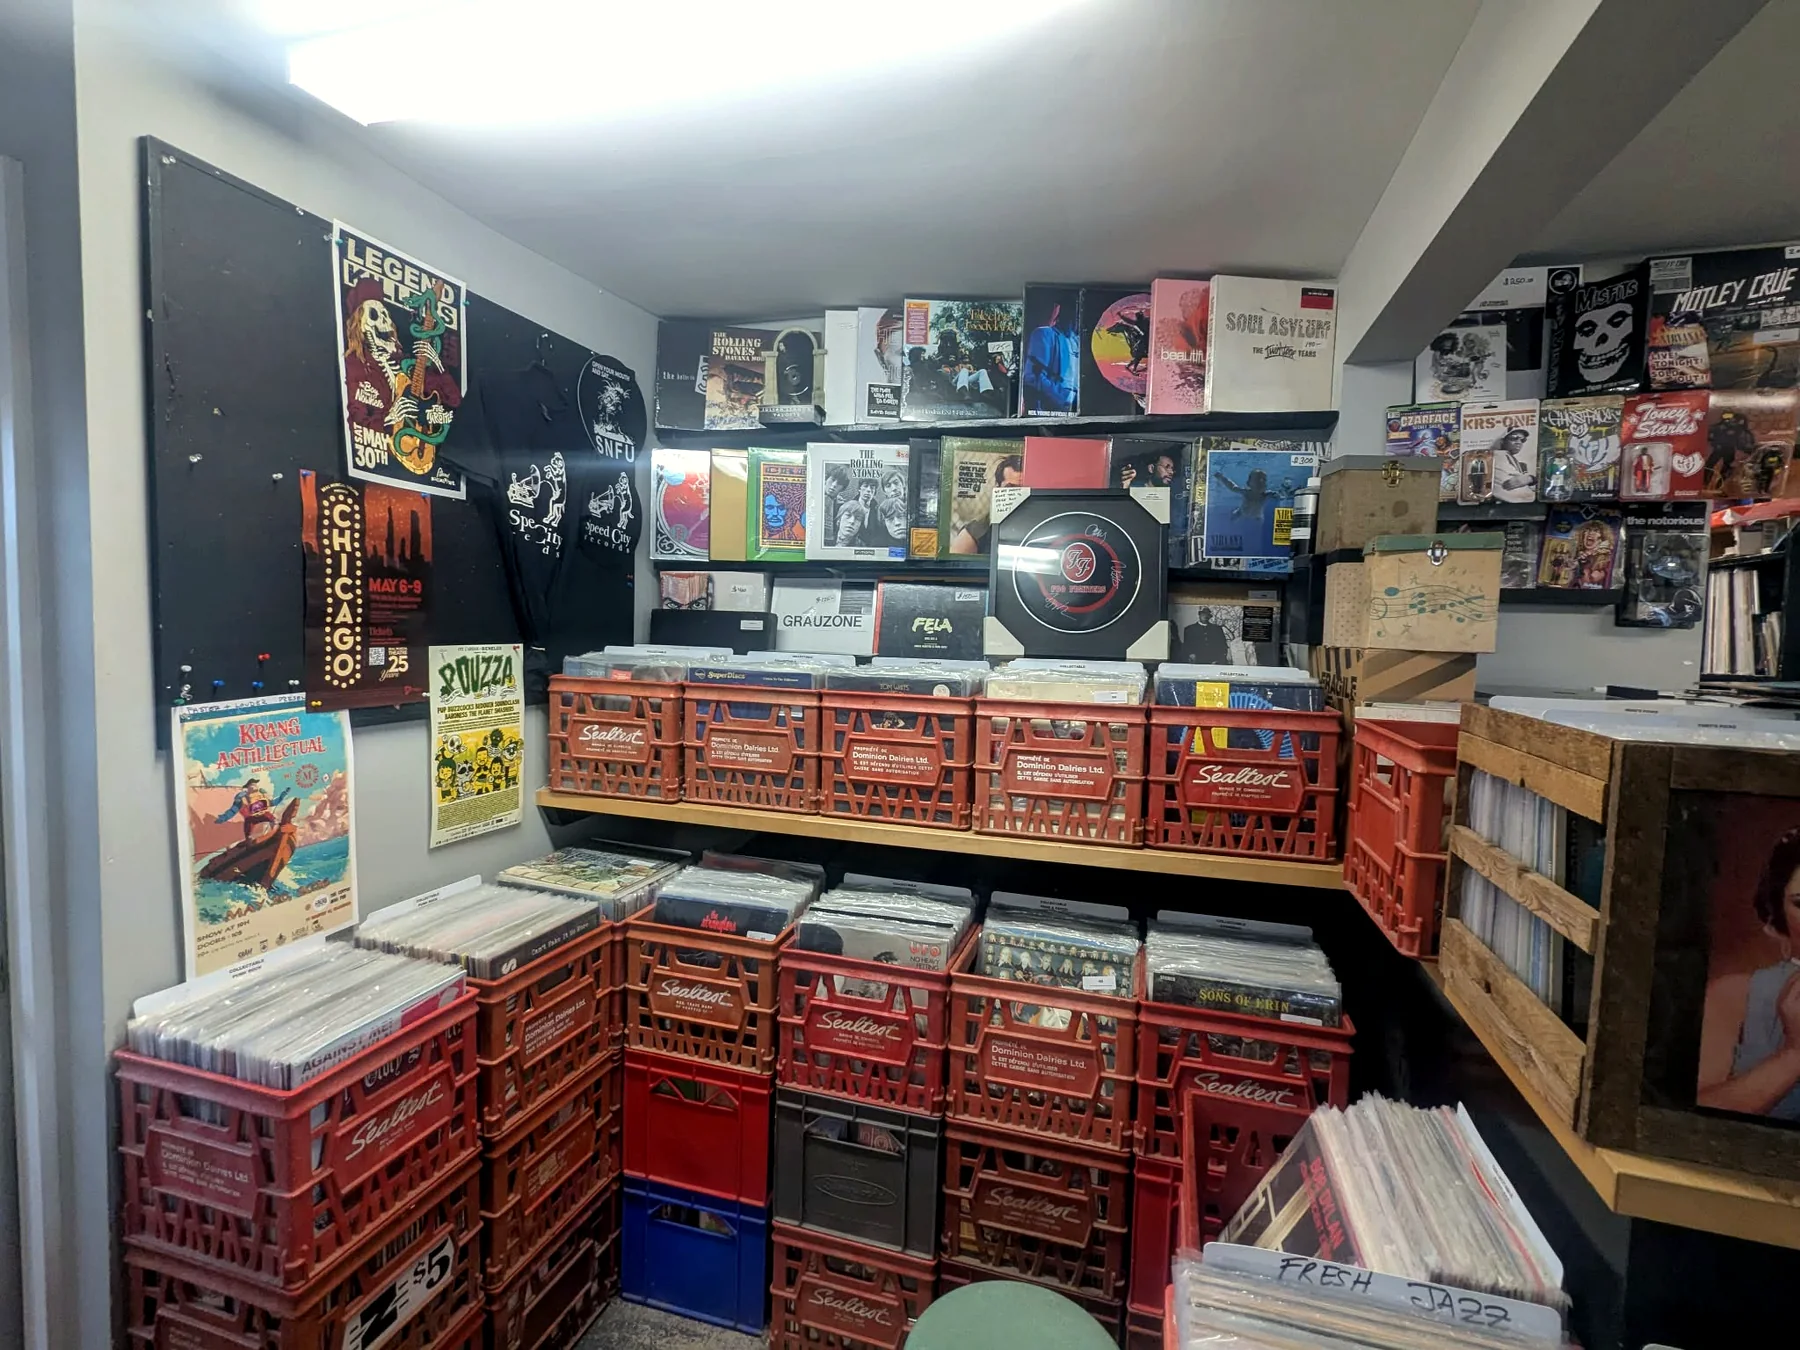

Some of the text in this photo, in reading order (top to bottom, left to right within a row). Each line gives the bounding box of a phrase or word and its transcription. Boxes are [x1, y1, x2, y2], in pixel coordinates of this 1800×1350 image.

[346, 237, 455, 305] LEGEND
[1672, 266, 1799, 312] MÖTLEY CRÜE
[1226, 312, 1331, 339] SOUL ASYLUM
[712, 346, 756, 357] STONES
[713, 337, 762, 348] ROLLING
[1253, 346, 1317, 358] THE YEARS
[1400, 413, 1457, 427] CZARFACE
[1463, 415, 1537, 431] KRS-ONE
[1635, 402, 1691, 423] Toney
[363, 427, 389, 451] MAY
[1633, 417, 1699, 439] Starks
[355, 443, 389, 469] 30TH
[595, 435, 635, 463] SNFU
[859, 450, 875, 459] THE
[850, 459, 883, 469] ROLLING
[852, 469, 881, 478] STONES
[1626, 516, 1705, 526] the notorious
[585, 520, 632, 546] Speed City
[332, 503, 355, 677] CHICAGO
[369, 577, 423, 594] MAY 6-9
[1051, 585, 1066, 593] FOO
[782, 614, 863, 628] GRAUZONE
[911, 617, 953, 634] FELA
[388, 655, 409, 673] 25
[438, 655, 514, 695] POUZZA
[707, 671, 746, 680] SuperDiscs
[1322, 671, 1358, 701] FRAGILE
[239, 717, 300, 744] KRANG
[578, 724, 645, 745] Sealtest
[216, 736, 326, 769] ANTILLECTUAL
[711, 742, 743, 751] Dominion
[744, 744, 767, 752] Dairies
[852, 751, 888, 761] Dominion
[889, 754, 915, 764] Dairies
[1017, 761, 1105, 774] Dominion Dairies Ltd.
[1192, 765, 1291, 788] Sealtest
[197, 929, 223, 942] SHOW
[225, 923, 236, 933] AT
[908, 941, 941, 957] UFO
[657, 978, 733, 1007] Sealtest
[1199, 988, 1231, 1004] SONS
[1254, 998, 1290, 1013] ERIN
[525, 1017, 555, 1041] Dominion
[816, 1010, 902, 1041] Sealtest
[991, 1045, 1087, 1070] Dominion Dairies Ltd.
[1194, 1071, 1298, 1108] Sealtest
[345, 1080, 444, 1162] Sealtest
[985, 1188, 1081, 1224] Sealtest
[1318, 1187, 1345, 1250] DYLAN
[413, 1236, 452, 1290] $5
[1278, 1257, 1512, 1328] FRESH JAZZ
[808, 1287, 892, 1326] Sealtest
